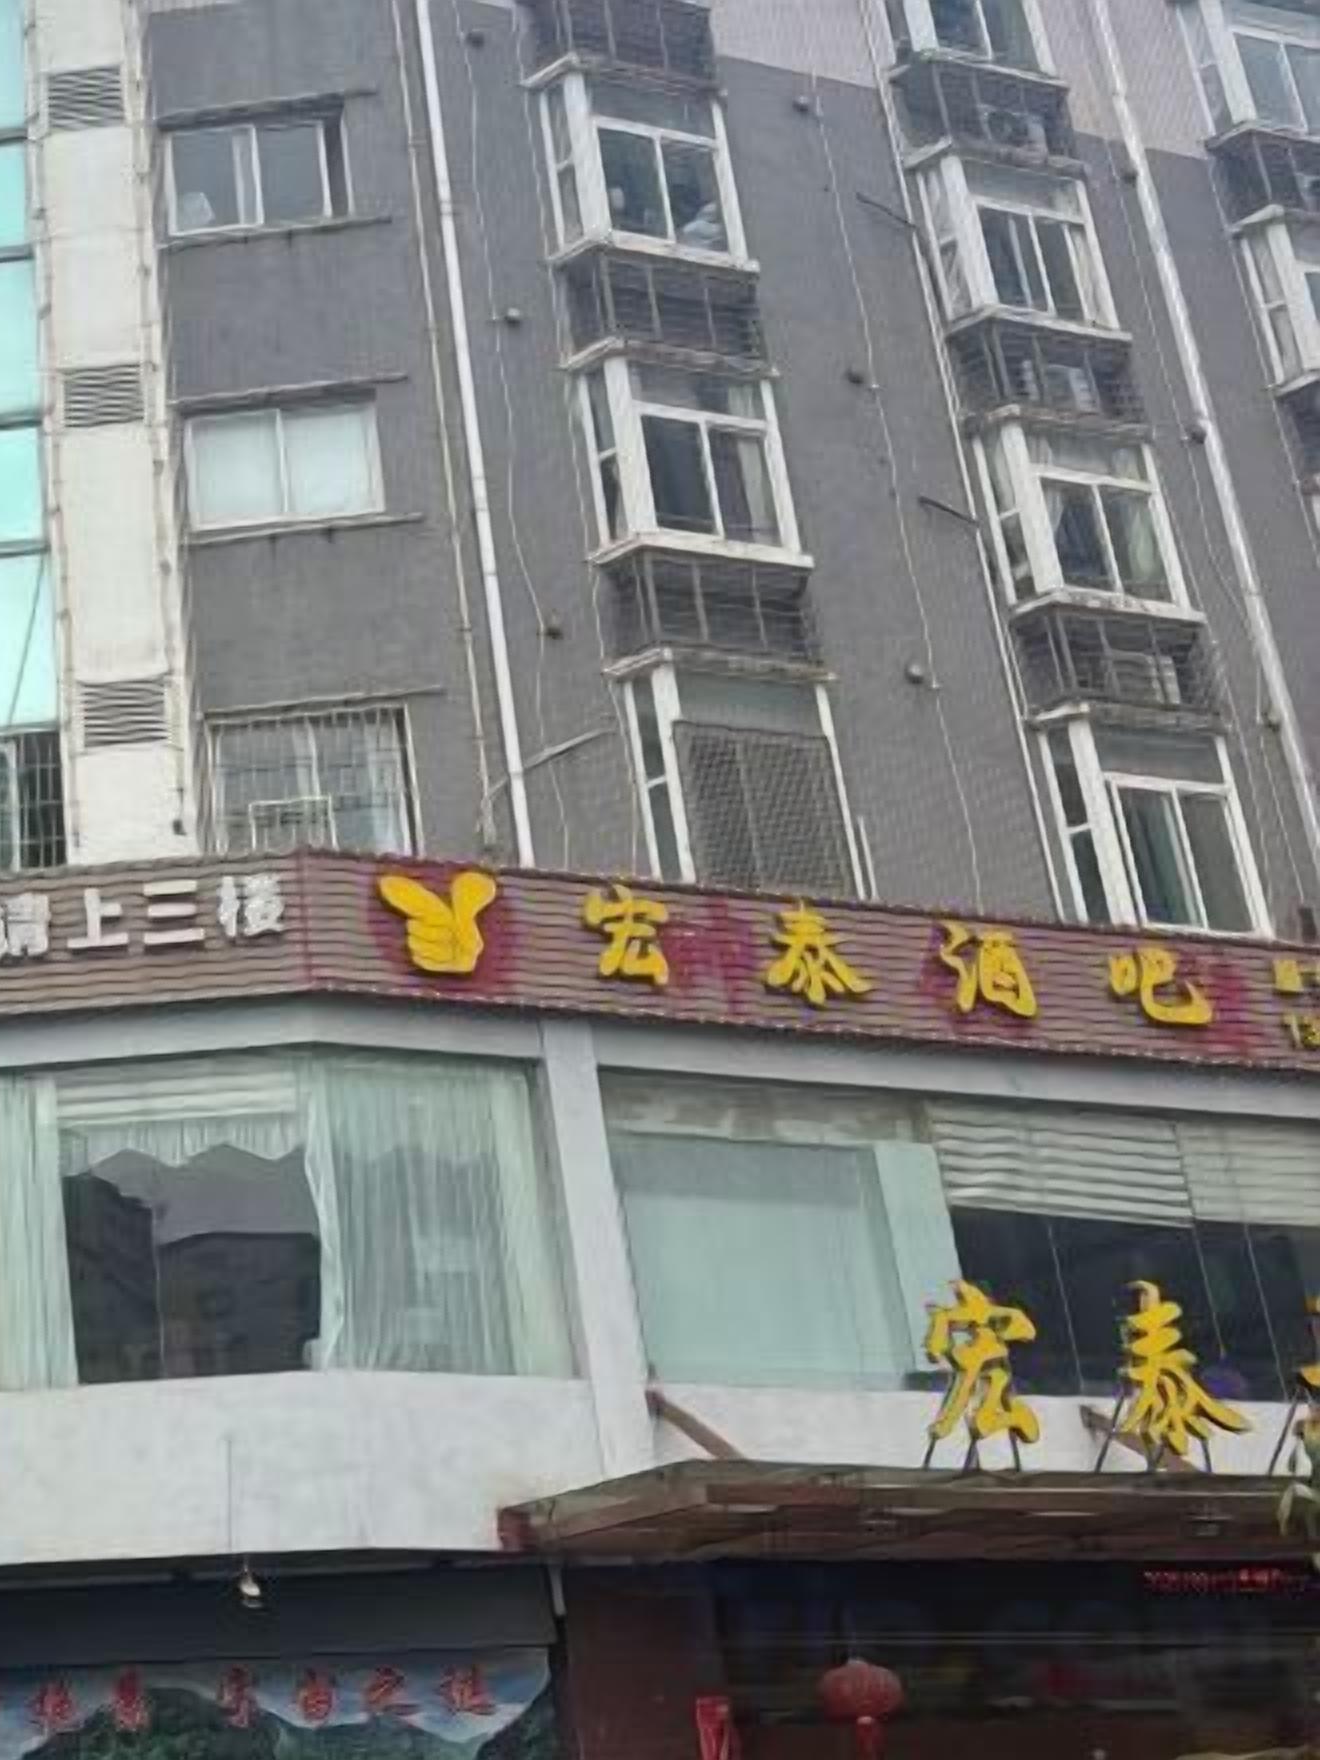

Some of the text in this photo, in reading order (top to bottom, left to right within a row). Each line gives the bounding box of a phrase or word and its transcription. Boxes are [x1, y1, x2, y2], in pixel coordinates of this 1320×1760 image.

[585, 882, 1215, 1027] 宏泰酒吧
[925, 1279, 1320, 1457] 宏泰
